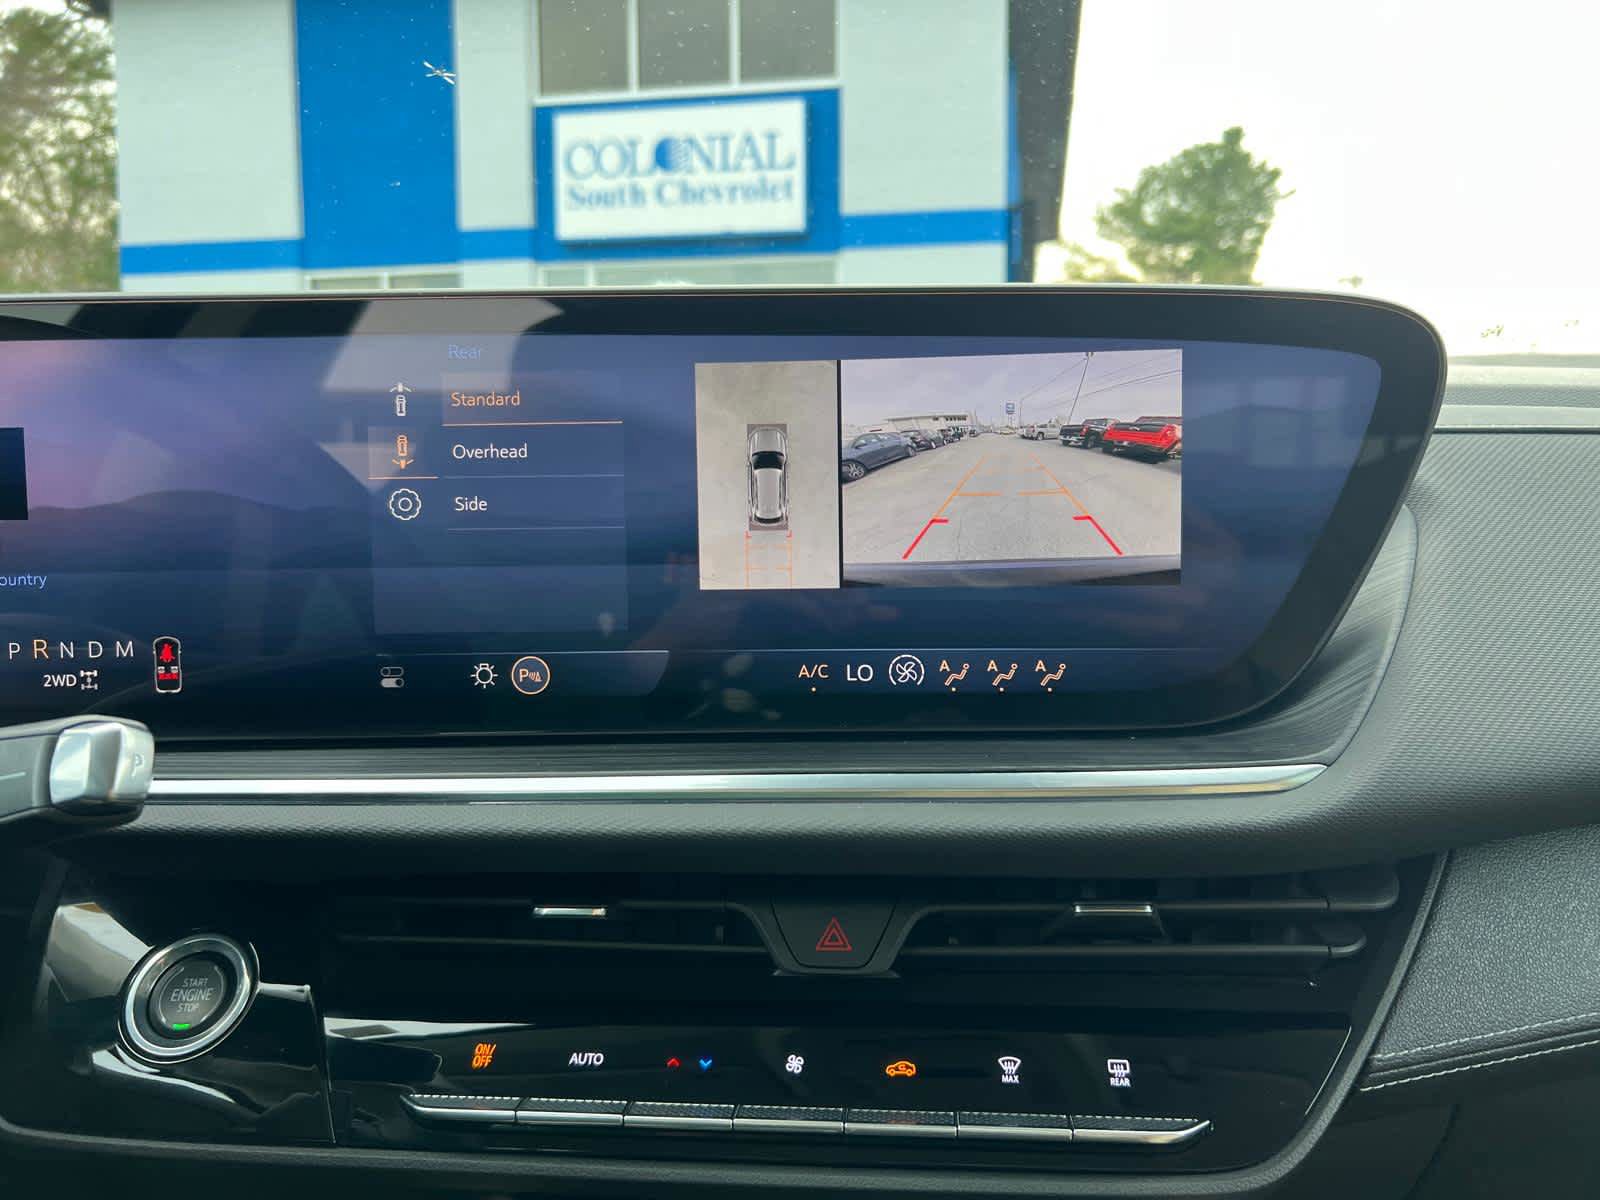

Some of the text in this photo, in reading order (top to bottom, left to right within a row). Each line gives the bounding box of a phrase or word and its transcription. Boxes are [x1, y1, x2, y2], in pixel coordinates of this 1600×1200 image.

[565, 130, 797, 179] COLONIAL
[569, 175, 794, 209] South Chevrolet
[448, 344, 483, 360] Rear
[451, 391, 520, 407] Standard
[453, 443, 528, 459] Overhead
[454, 496, 488, 512] Side
[798, 664, 829, 679] A/C
[939, 659, 950, 672] A
[987, 659, 998, 672] A
[1035, 659, 1046, 672] A
[846, 664, 874, 682] LO
[43, 674, 77, 688] 2WD
[182, 978, 208, 988] START
[170, 987, 215, 1002] ENGINE
[176, 1002, 199, 1013] STOP
[474, 1042, 497, 1056] ON/
[472, 1055, 492, 1069] OFF
[568, 1052, 605, 1066] AUTO
[1001, 1074, 1020, 1084] MAX
[1109, 1077, 1131, 1088] REAR
